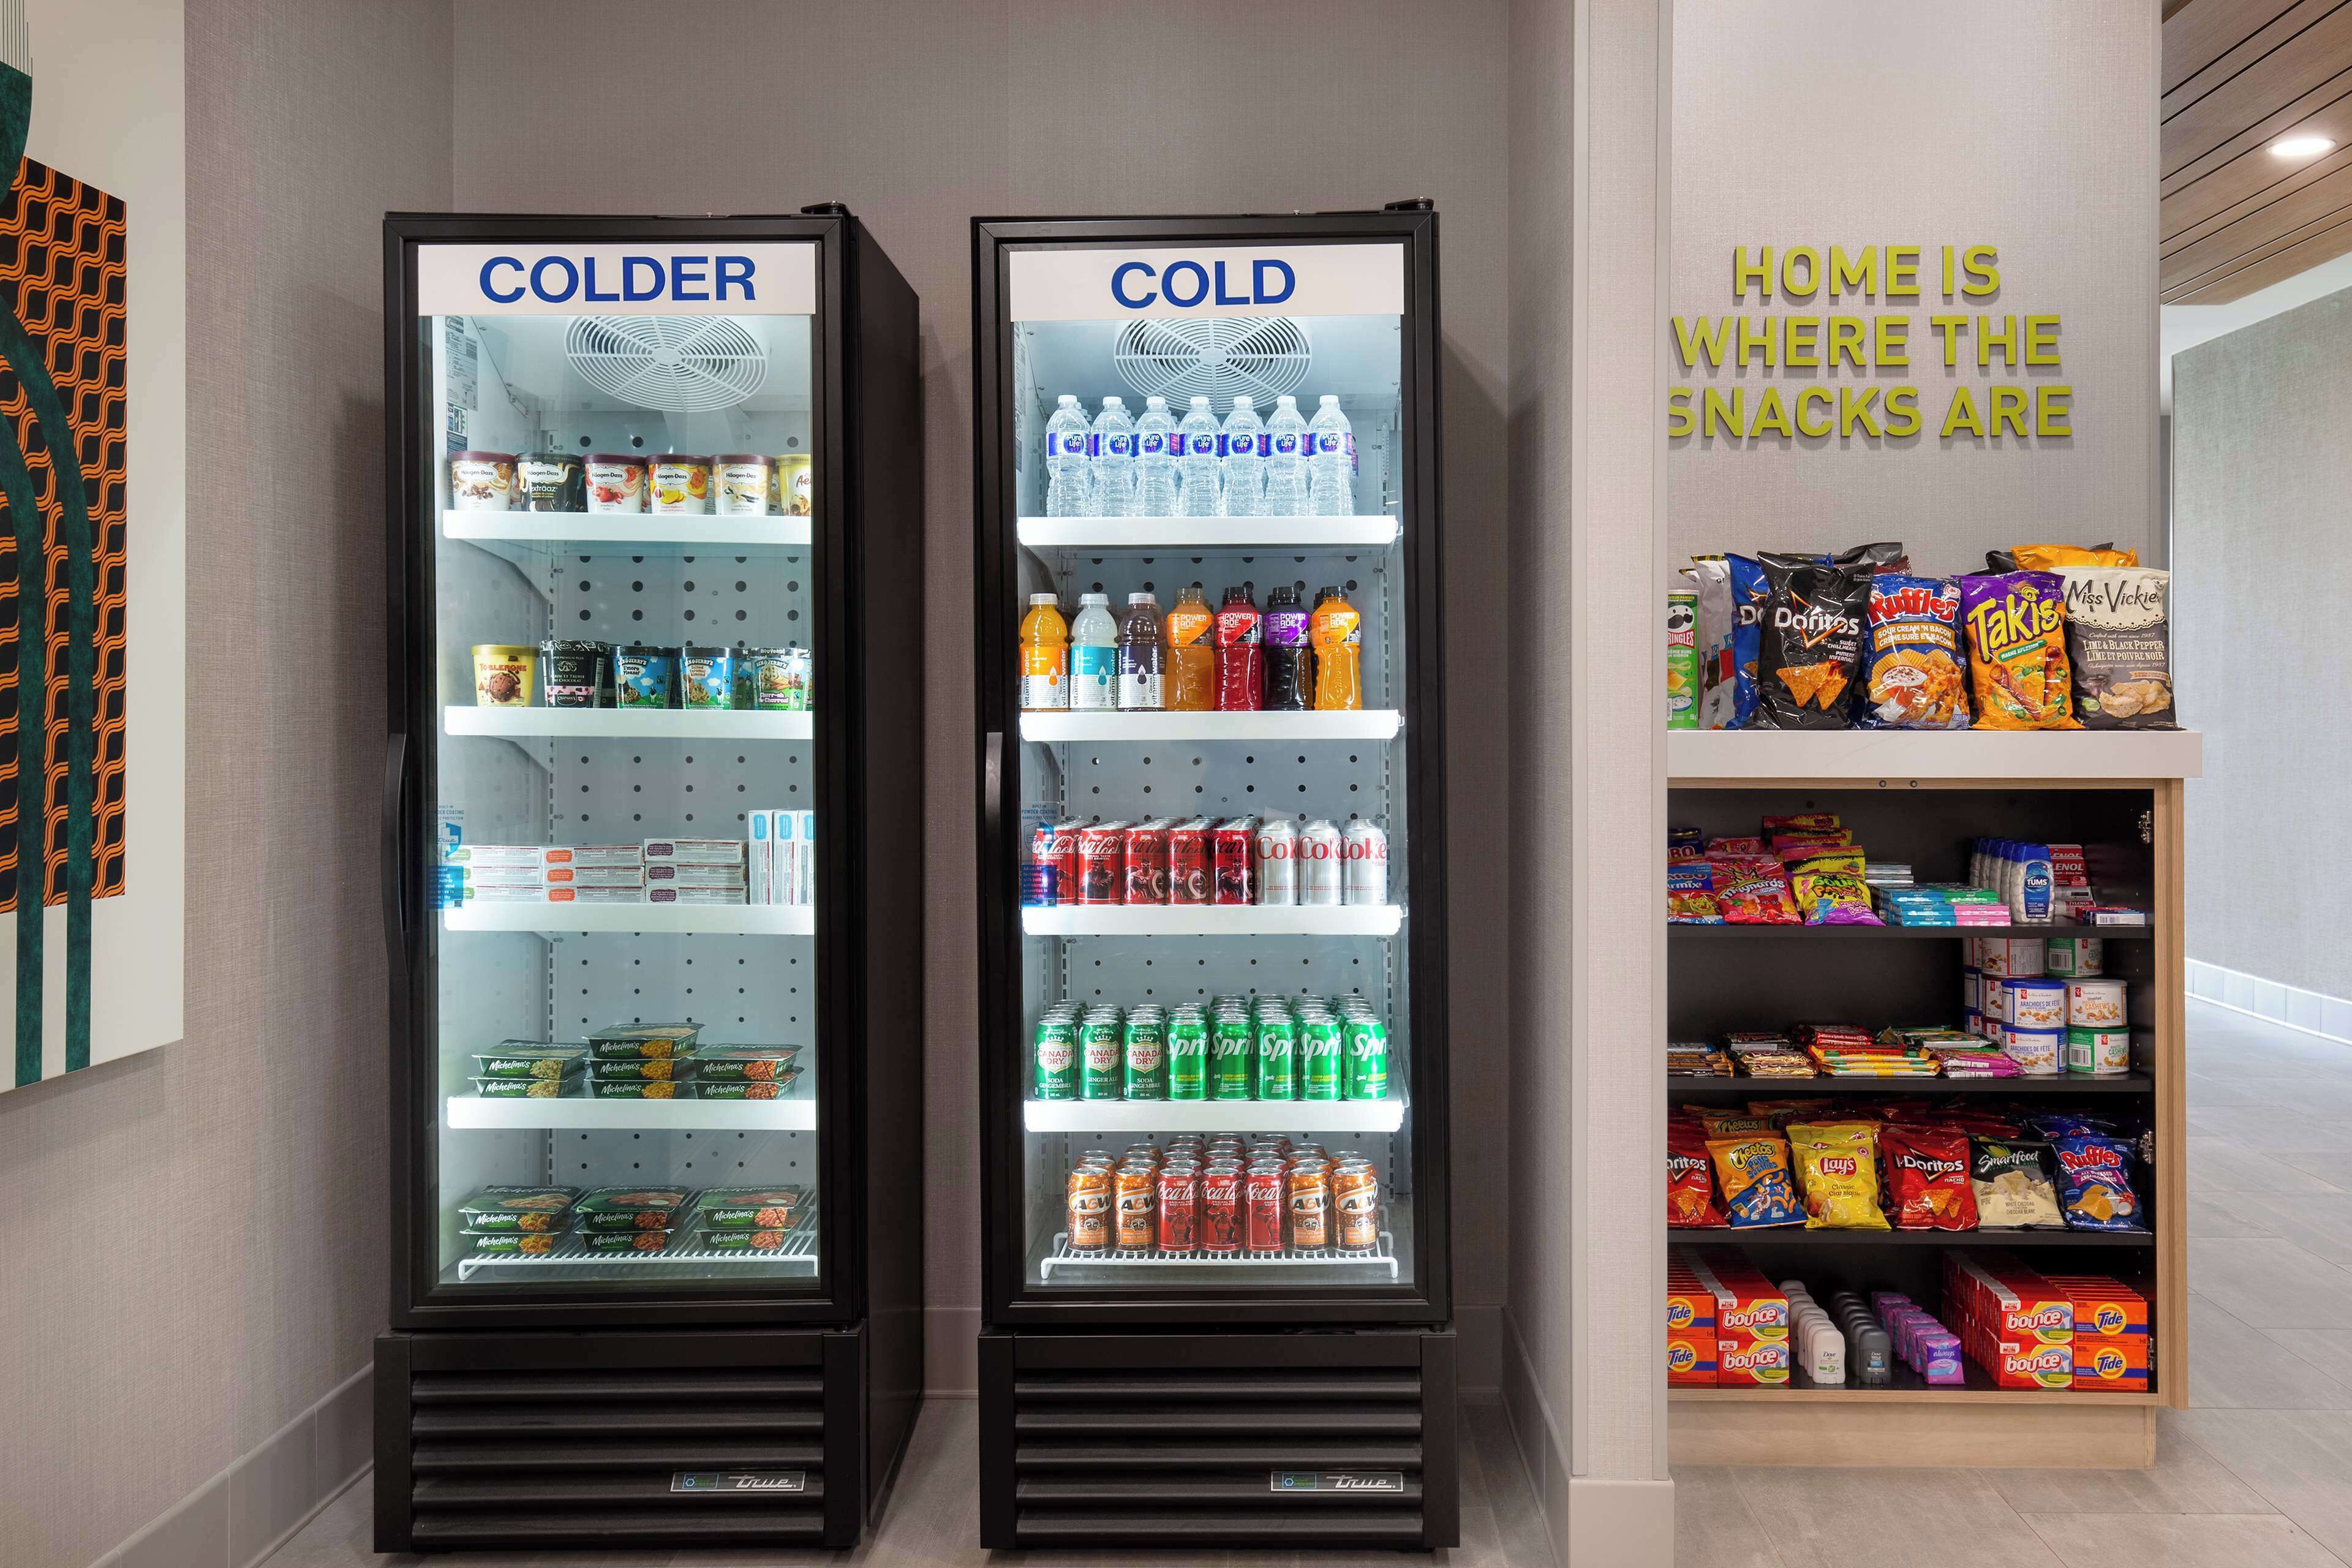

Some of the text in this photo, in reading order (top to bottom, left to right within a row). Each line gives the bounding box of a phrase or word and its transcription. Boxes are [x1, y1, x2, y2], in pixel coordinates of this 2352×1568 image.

[1734, 245, 2000, 296] HOME IS
[480, 256, 756, 303] COLDER
[1111, 259, 1296, 309] COLD
[1672, 315, 2060, 366] WHERE THE
[1668, 386, 2073, 437] SNACKS ARE
[2066, 579, 2103, 614] Miss
[1868, 587, 1960, 627] Ruffles
[1774, 606, 1860, 636] Doritos
[1967, 592, 2059, 662] Takis
[1878, 626, 1896, 638] SOUR
[1929, 625, 1951, 638] BACON
[1932, 633, 1953, 647] BACON
[2082, 640, 2102, 650] LIME
[2108, 639, 2133, 650] BLACK
[2133, 640, 2165, 650] PEPPER
[2086, 650, 2165, 662] LIME ET POIVRE NOIR
[479, 663, 527, 672] TOBLERONE
[599, 1041, 639, 1052] Michelina's
[1166, 1031, 1209, 1061] Spri
[489, 1060, 530, 1071] Michelina's
[600, 1063, 640, 1074] Michelina's
[703, 1063, 744, 1073] Michelina's
[486, 1081, 527, 1093] Michelina's
[601, 1084, 641, 1095] Michelina's
[705, 1085, 745, 1096] Michelina's
[1730, 1142, 1775, 1170] Cheetos
[1904, 1155, 1964, 1172] Doritos
[1978, 1150, 2039, 1174] Smartfood
[2060, 1145, 2123, 1172] Ruffles
[1823, 1158, 1855, 1175] Lay's
[1074, 1195, 1111, 1210] A&W
[1121, 1195, 1156, 1210] A&W
[1292, 1195, 1330, 1210] A&W
[1343, 1194, 1377, 1210] A&W
[476, 1213, 518, 1225] Michelina's
[593, 1213, 633, 1224] Michelina's
[713, 1210, 755, 1221] Michelina's
[477, 1235, 518, 1248] Michelina's
[592, 1235, 632, 1246] Michelina's
[710, 1233, 750, 1244] Michelina's
[1667, 1306, 1691, 1323] Tide
[1724, 1308, 1778, 1329] bounce
[2007, 1311, 2062, 1331] bounce
[2097, 1311, 2124, 1330] Tide
[1668, 1350, 1693, 1366] Tide
[1724, 1350, 1778, 1371] bounce
[1933, 1349, 1955, 1358] always
[2005, 1354, 2062, 1374] bounce
[2097, 1355, 2124, 1374] Tide
